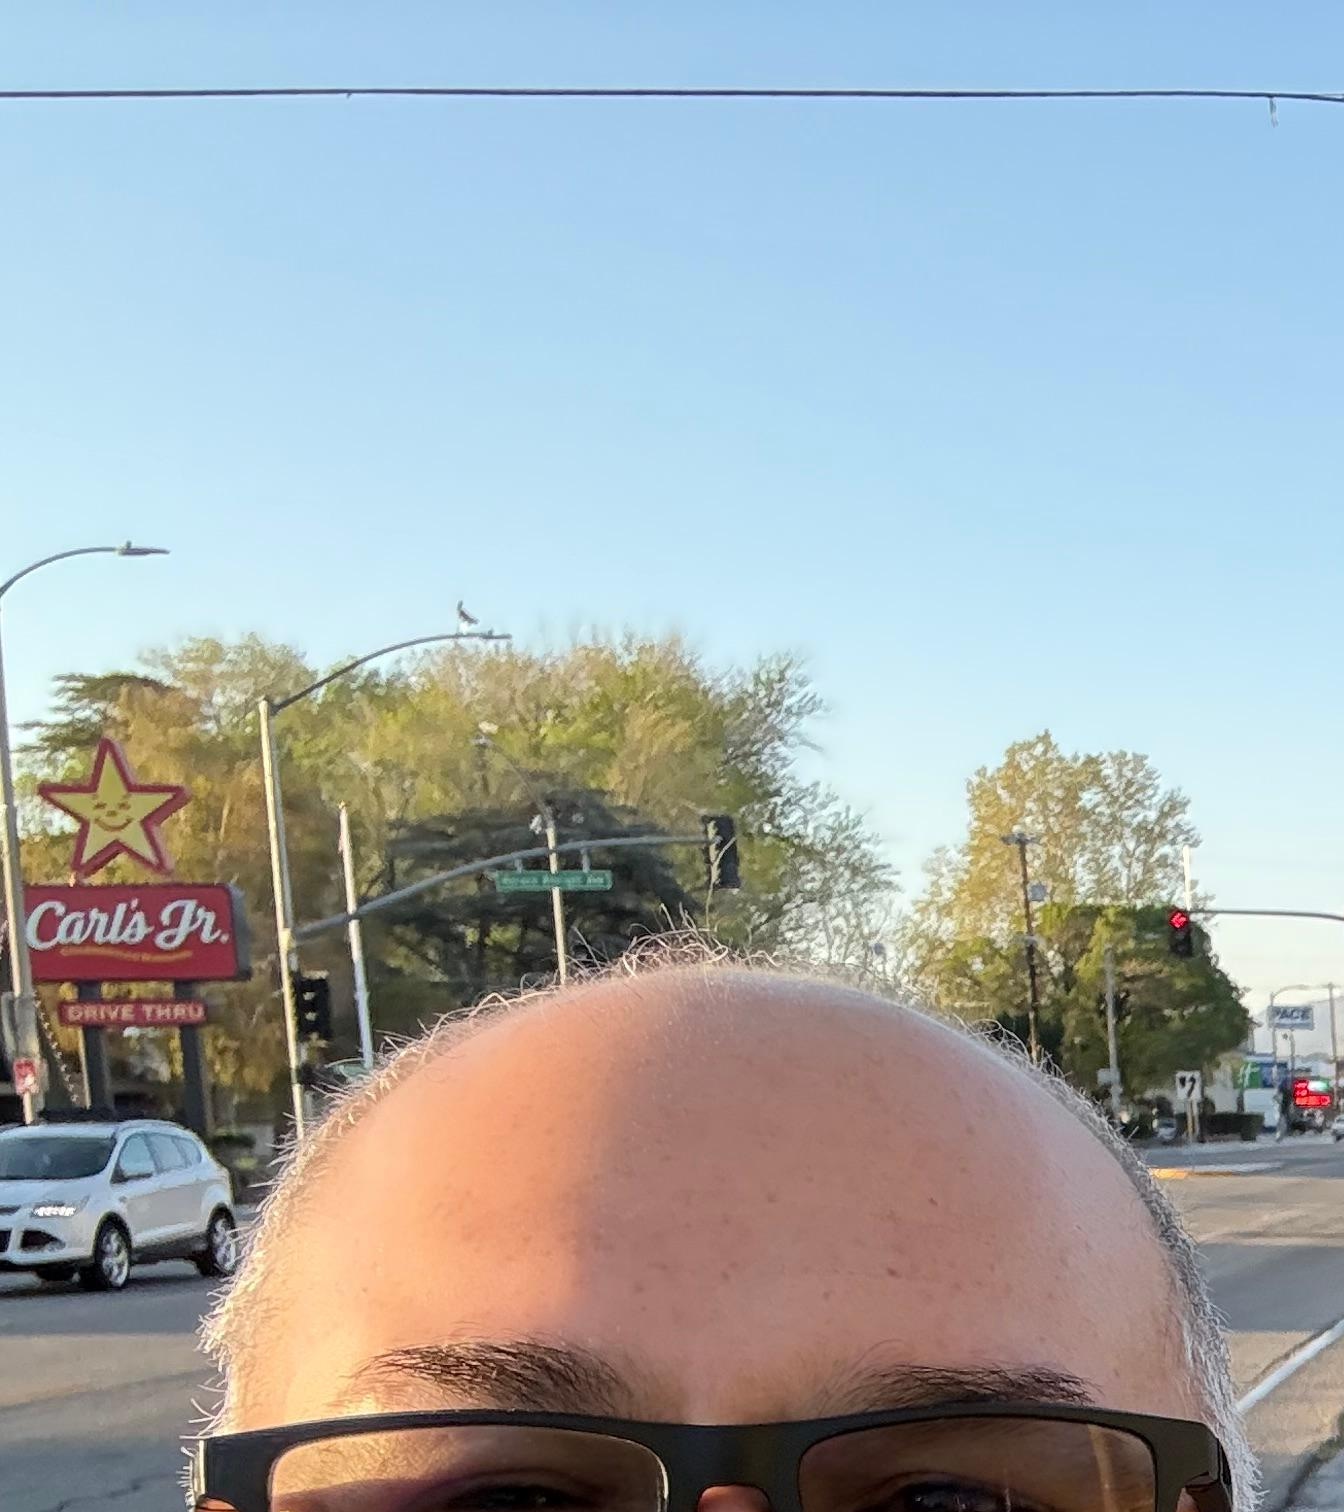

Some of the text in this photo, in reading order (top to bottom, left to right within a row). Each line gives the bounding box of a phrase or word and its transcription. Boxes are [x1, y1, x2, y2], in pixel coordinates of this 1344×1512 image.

[26, 898, 230, 951] Carl's Jr.
[68, 1004, 205, 1022] DRIVE THRU
